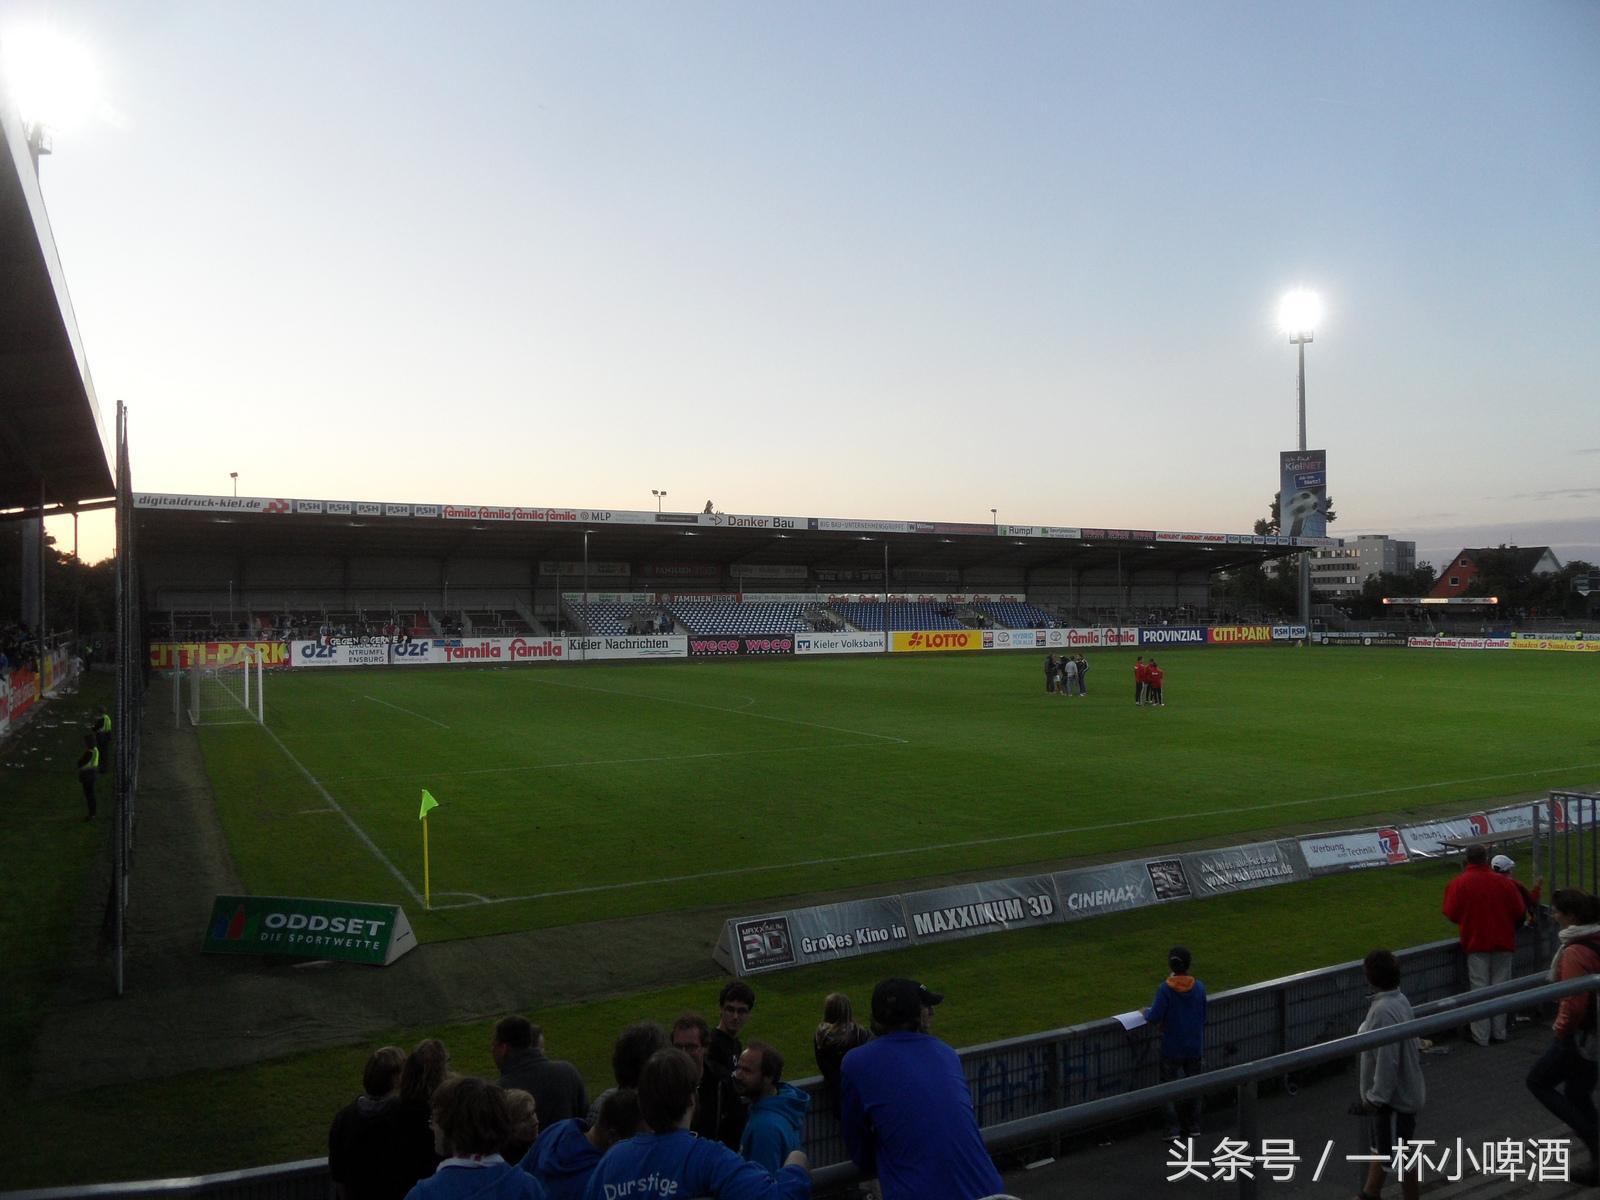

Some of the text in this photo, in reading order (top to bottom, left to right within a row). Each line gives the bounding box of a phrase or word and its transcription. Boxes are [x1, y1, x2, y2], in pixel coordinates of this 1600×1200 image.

[138, 495, 261, 509] digitaldruck-kiel.de
[443, 505, 476, 519] famila
[478, 506, 511, 520] famila
[511, 507, 544, 521] famila
[545, 508, 577, 523] famila
[591, 511, 611, 521] MLP
[727, 515, 794, 528] Danker Bau
[925, 633, 968, 648] LOTTO
[1066, 629, 1099, 647] famila
[1103, 628, 1135, 645] famila
[1143, 630, 1203, 642] PROVINZIAL
[1213, 626, 1270, 641] CITTI-PARK
[569, 638, 669, 650] Kieler Nachrichten
[690, 640, 739, 652] weco
[745, 639, 792, 651] weco
[813, 639, 884, 649] Kieler Volksbank
[1409, 637, 1432, 647] famila
[1432, 638, 1456, 648] famila
[1457, 638, 1483, 648] famila
[1484, 639, 1509, 648] famila
[508, 639, 562, 660] famila
[1310, 843, 1345, 853] Werbung
[1067, 883, 1146, 911] CINEMAXX
[913, 895, 1053, 935] MAXXIMUM 3D
[264, 913, 386, 936] ODDSET
[260, 932, 380, 950] DIE SPORTWETTE
[801, 925, 906, 954] Großes Kino in
[603, 1171, 679, 1200] Durstige
